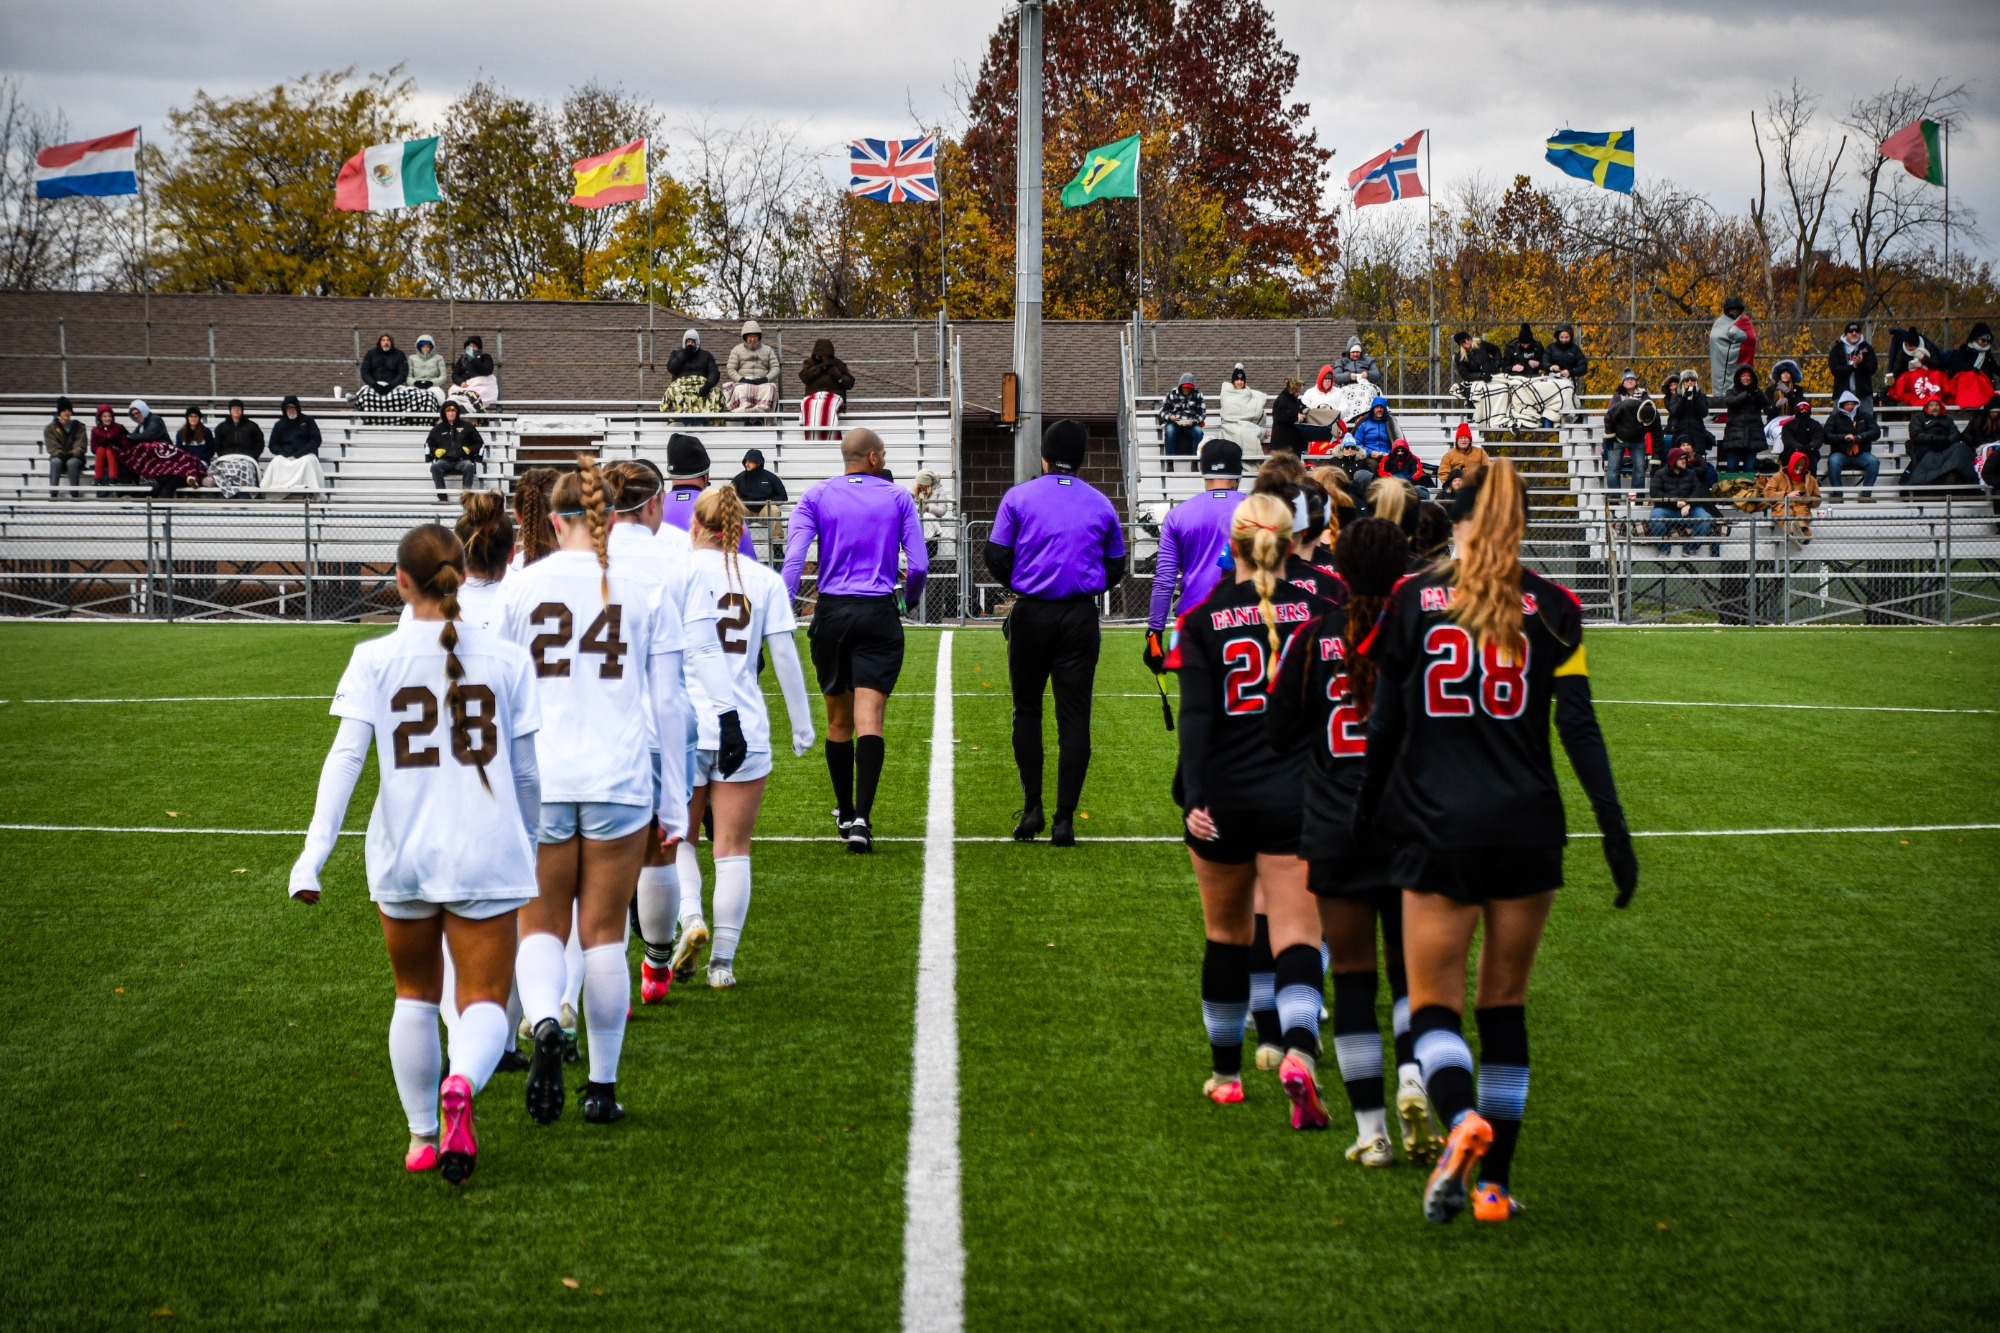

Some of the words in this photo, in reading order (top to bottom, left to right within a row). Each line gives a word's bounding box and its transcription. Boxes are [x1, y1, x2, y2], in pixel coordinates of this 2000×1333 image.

[530, 602, 627, 679] 24
[710, 591, 752, 655] 2
[1211, 602, 1310, 631] PANTERS
[1424, 624, 1531, 720] 28
[390, 684, 498, 770] 28
